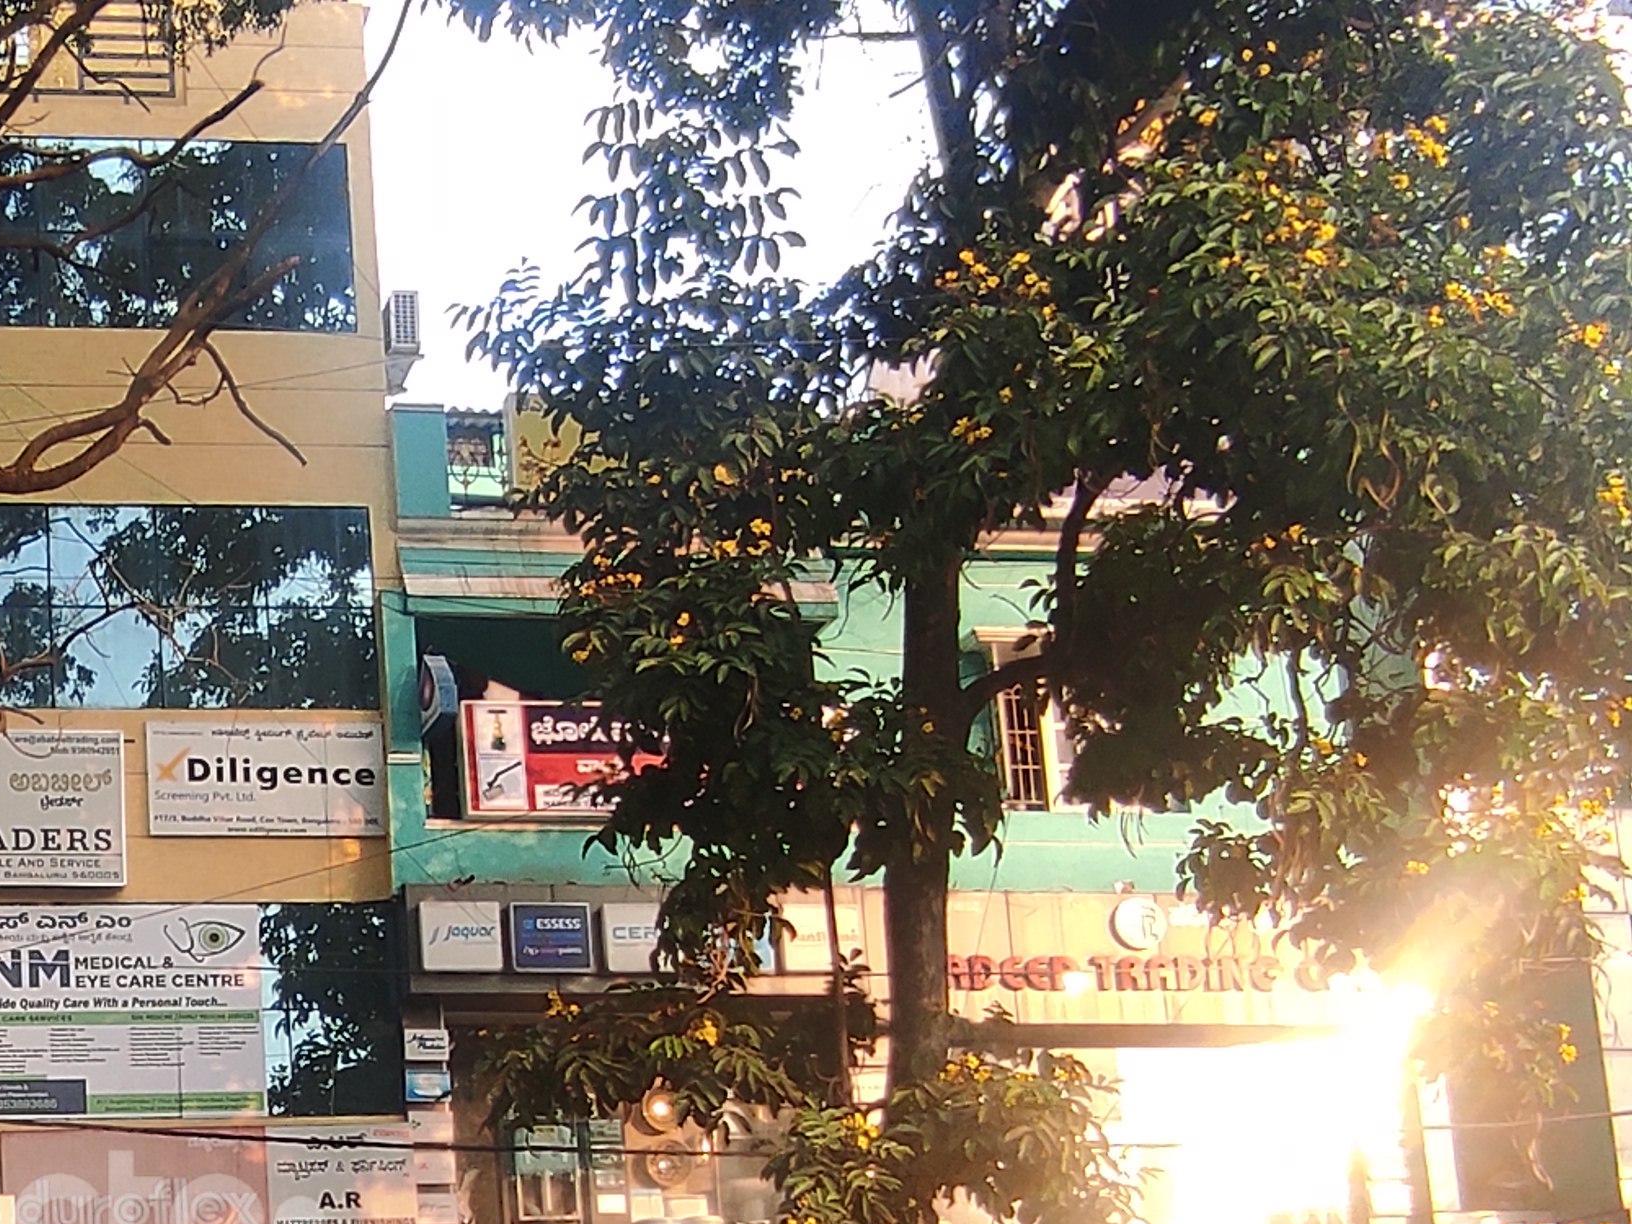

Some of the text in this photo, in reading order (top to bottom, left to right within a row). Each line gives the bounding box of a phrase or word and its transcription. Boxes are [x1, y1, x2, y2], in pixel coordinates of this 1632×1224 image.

[9, 768, 113, 793] ಅಬಬೀಲ್
[187, 756, 376, 791] Diligence
[154, 790, 256, 804] Screening Pvt. Ltd.
[18, 857, 44, 868] AND
[50, 857, 101, 868] SERVICE
[36, 911, 89, 929] ಎನ್
[95, 913, 132, 929] ಎಂ
[536, 918, 582, 930] ESSESS
[442, 924, 496, 941] Jaquar
[612, 926, 658, 939] CER
[74, 956, 156, 970] MEDICAL
[161, 956, 174, 970] &
[75, 973, 245, 989] EYE CARE CENTRE
[947, 955, 1071, 992] ADEED
[1087, 955, 1282, 993] TRADING
[20, 998, 60, 1012] Quality
[63, 998, 90, 1009] Care
[93, 997, 118, 1009] With
[121, 1000, 129, 1009] a
[132, 997, 181, 1009] Personal
[319, 1191, 362, 1210] A.R
